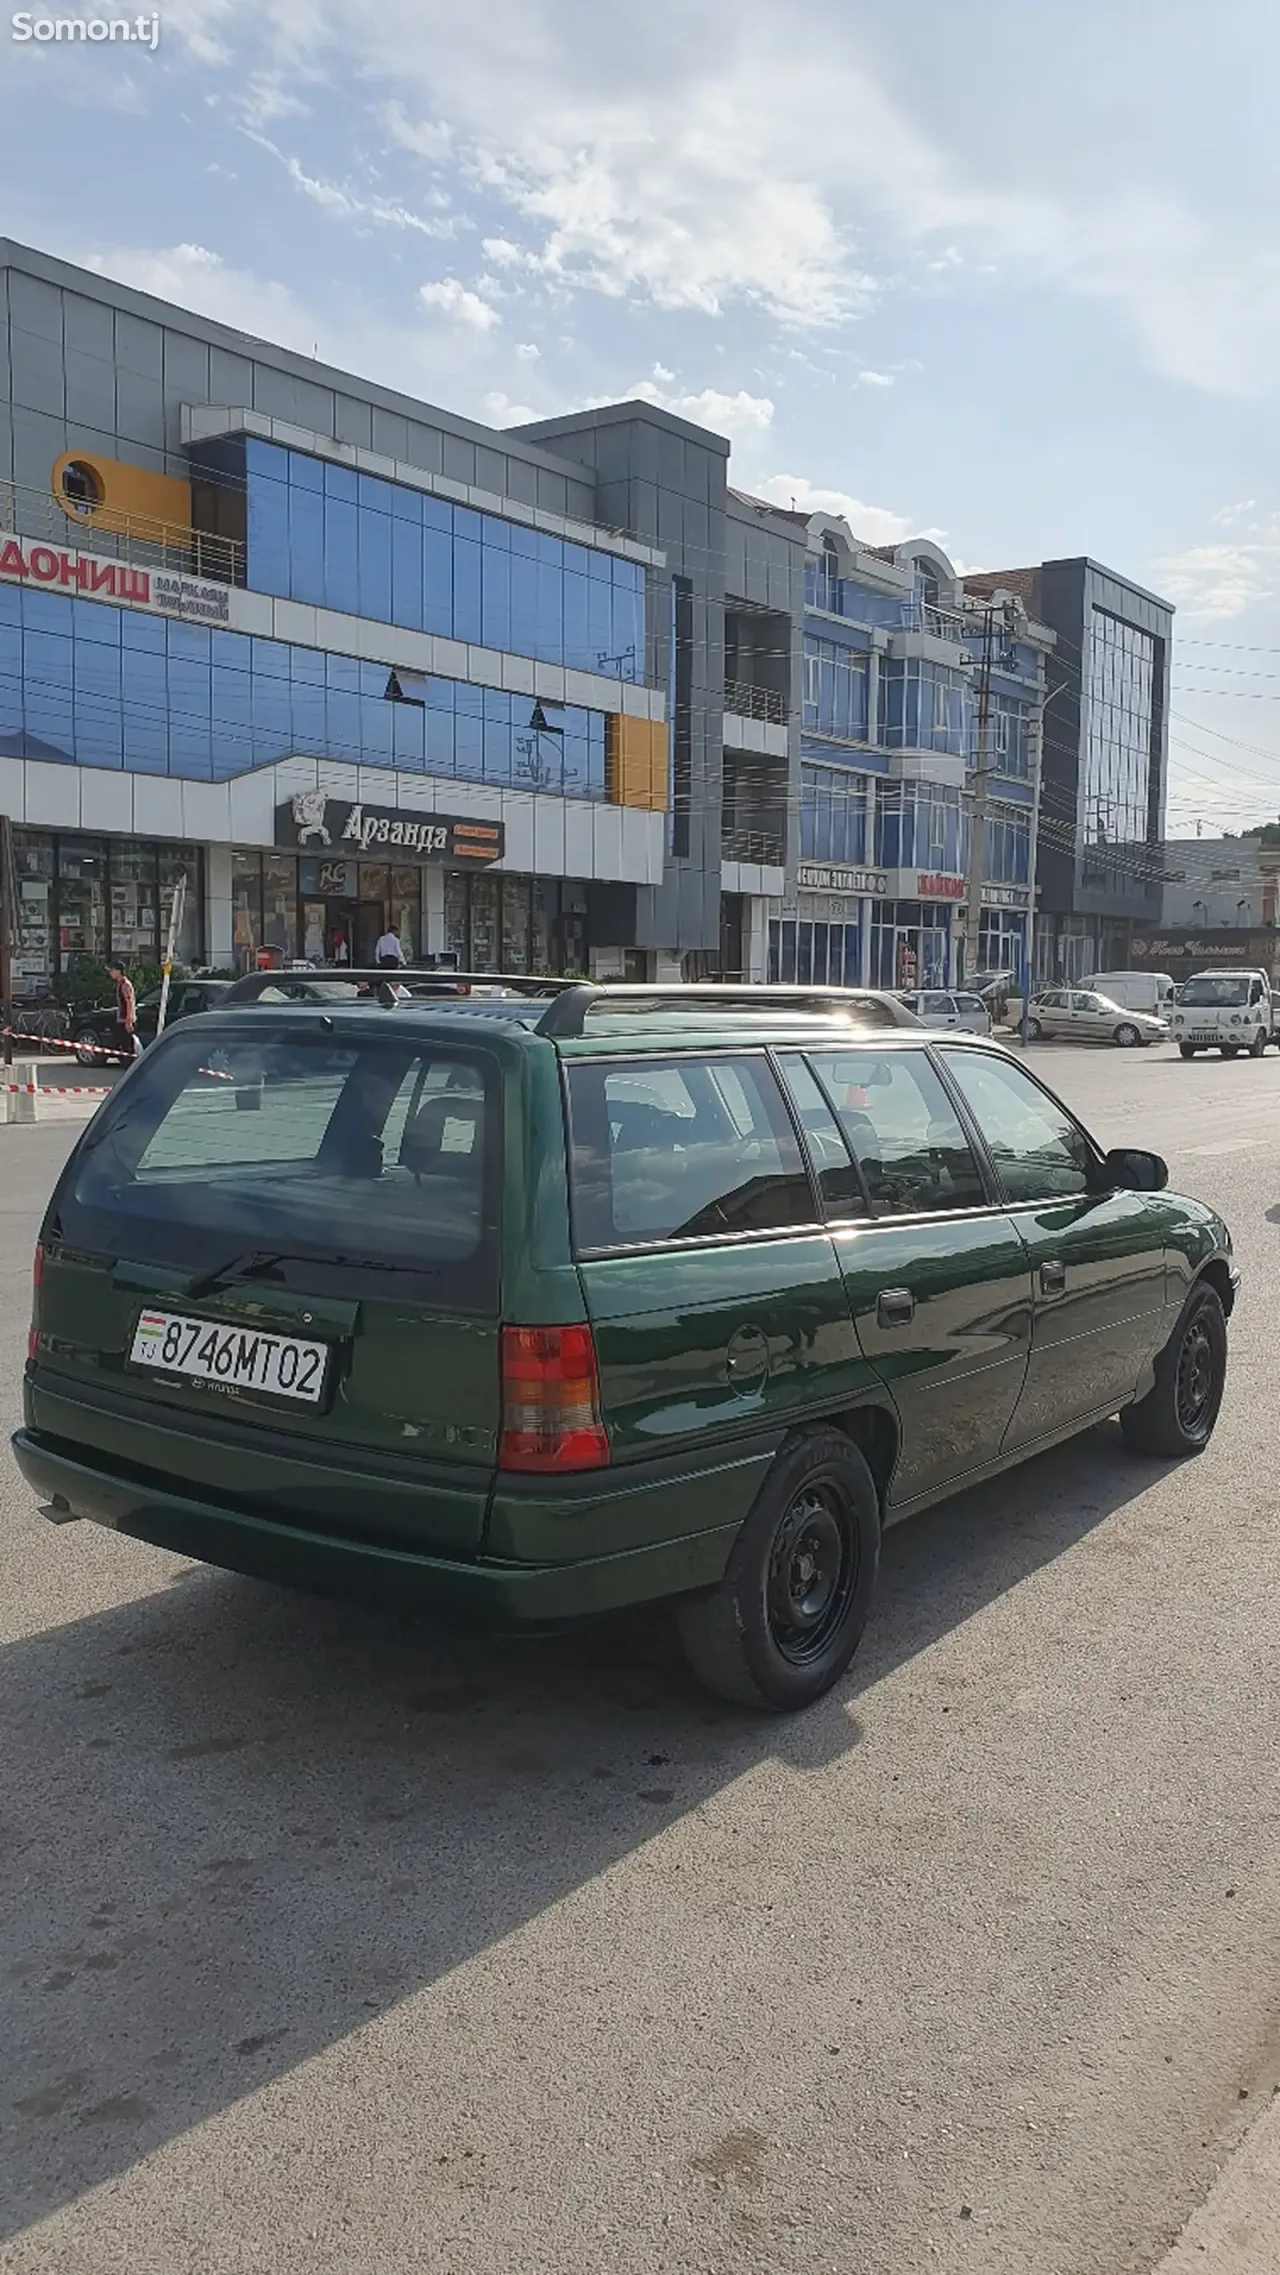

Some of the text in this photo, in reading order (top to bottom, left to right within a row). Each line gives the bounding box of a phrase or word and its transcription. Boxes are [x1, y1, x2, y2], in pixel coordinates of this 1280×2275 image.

[0, 540, 150, 603] ДОНИШ
[341, 805, 447, 853] Арзанда
[141, 1341, 156, 1359] TJ
[161, 1321, 320, 1394] 8746MT02
